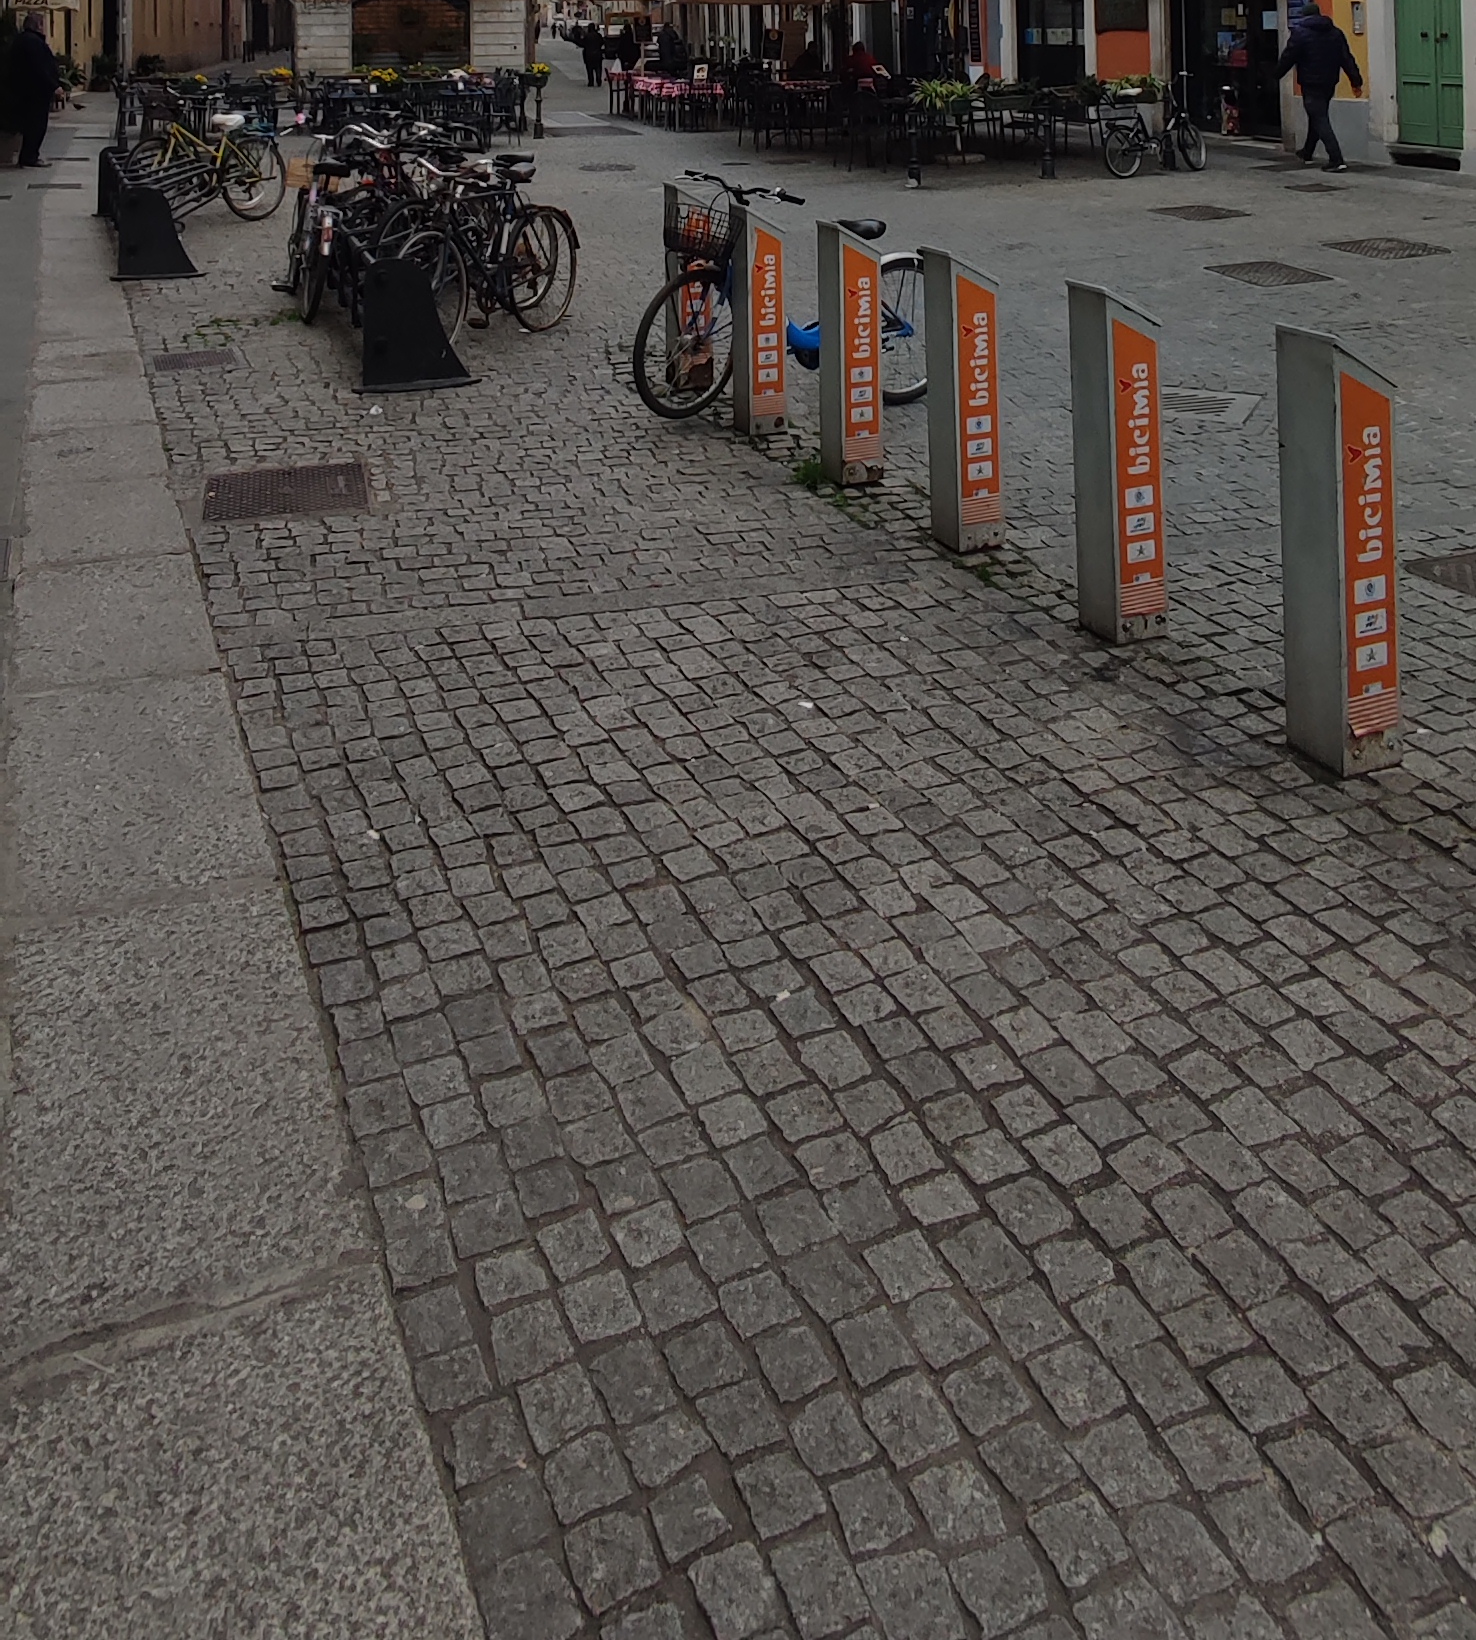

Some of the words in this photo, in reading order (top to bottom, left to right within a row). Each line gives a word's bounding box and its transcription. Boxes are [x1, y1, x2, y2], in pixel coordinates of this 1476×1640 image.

[849, 277, 871, 358] bicimia
[963, 312, 989, 406] bicimia
[1120, 363, 1150, 475] bicimia
[1348, 425, 1383, 563] bicimia
